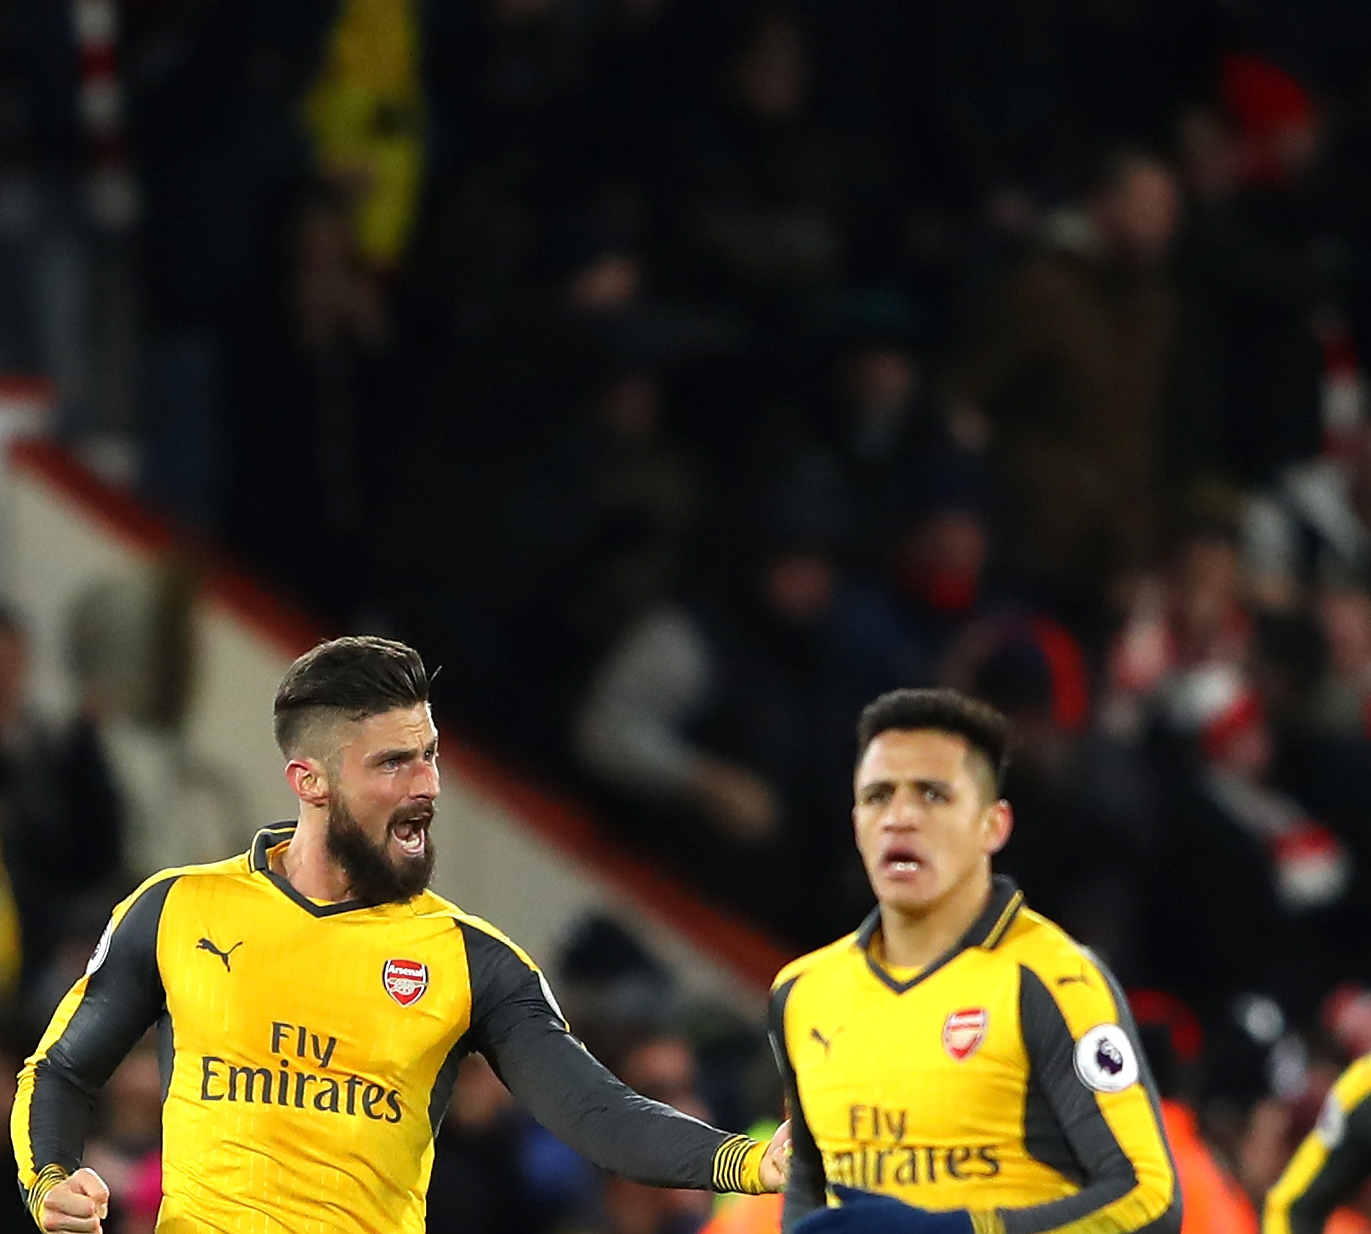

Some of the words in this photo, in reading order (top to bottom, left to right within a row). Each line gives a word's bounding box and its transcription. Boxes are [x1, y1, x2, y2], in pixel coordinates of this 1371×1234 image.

[271, 1021, 337, 1068] Fly
[200, 1056, 402, 1124] Emirates
[850, 1104, 907, 1141] Fly
[829, 1141, 1000, 1187] mirates
